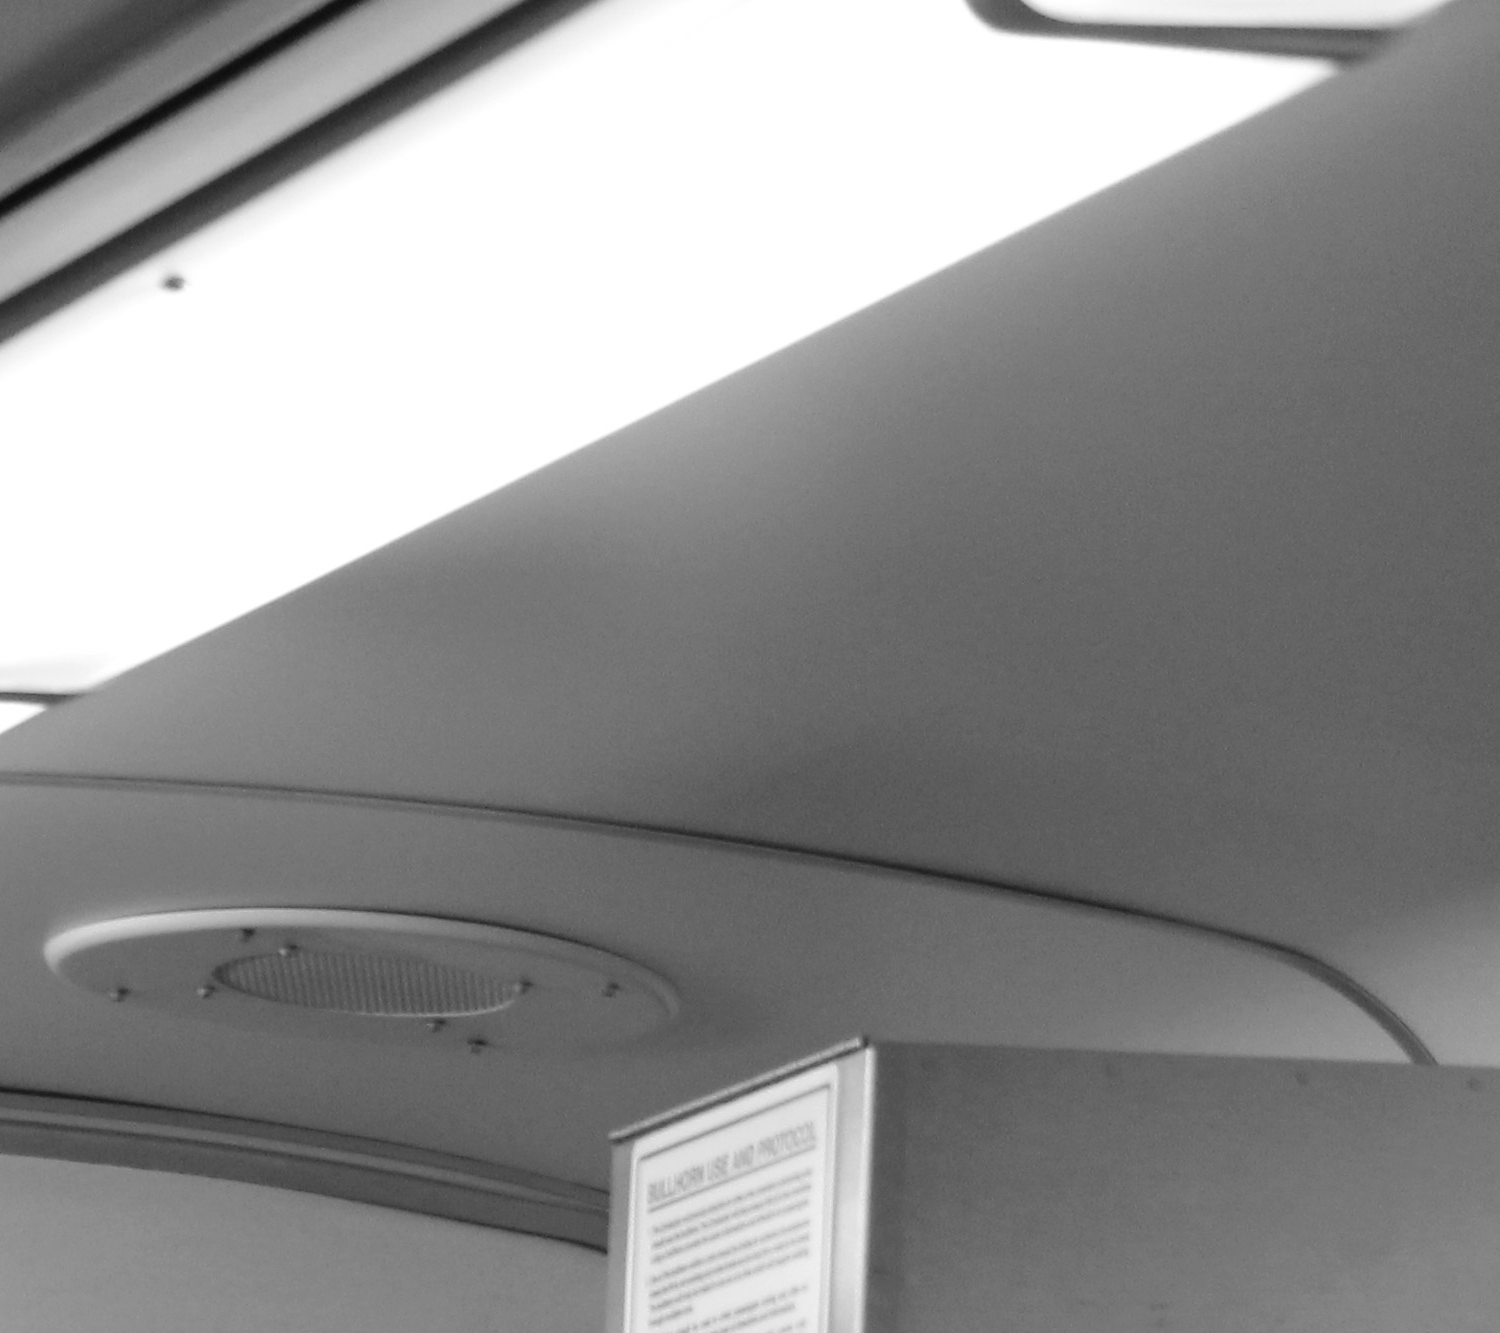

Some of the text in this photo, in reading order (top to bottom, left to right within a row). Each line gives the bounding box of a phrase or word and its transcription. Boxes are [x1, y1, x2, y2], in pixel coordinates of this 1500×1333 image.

[648, 1121, 816, 1203] BULLHORN USE AND PROTOCOL
